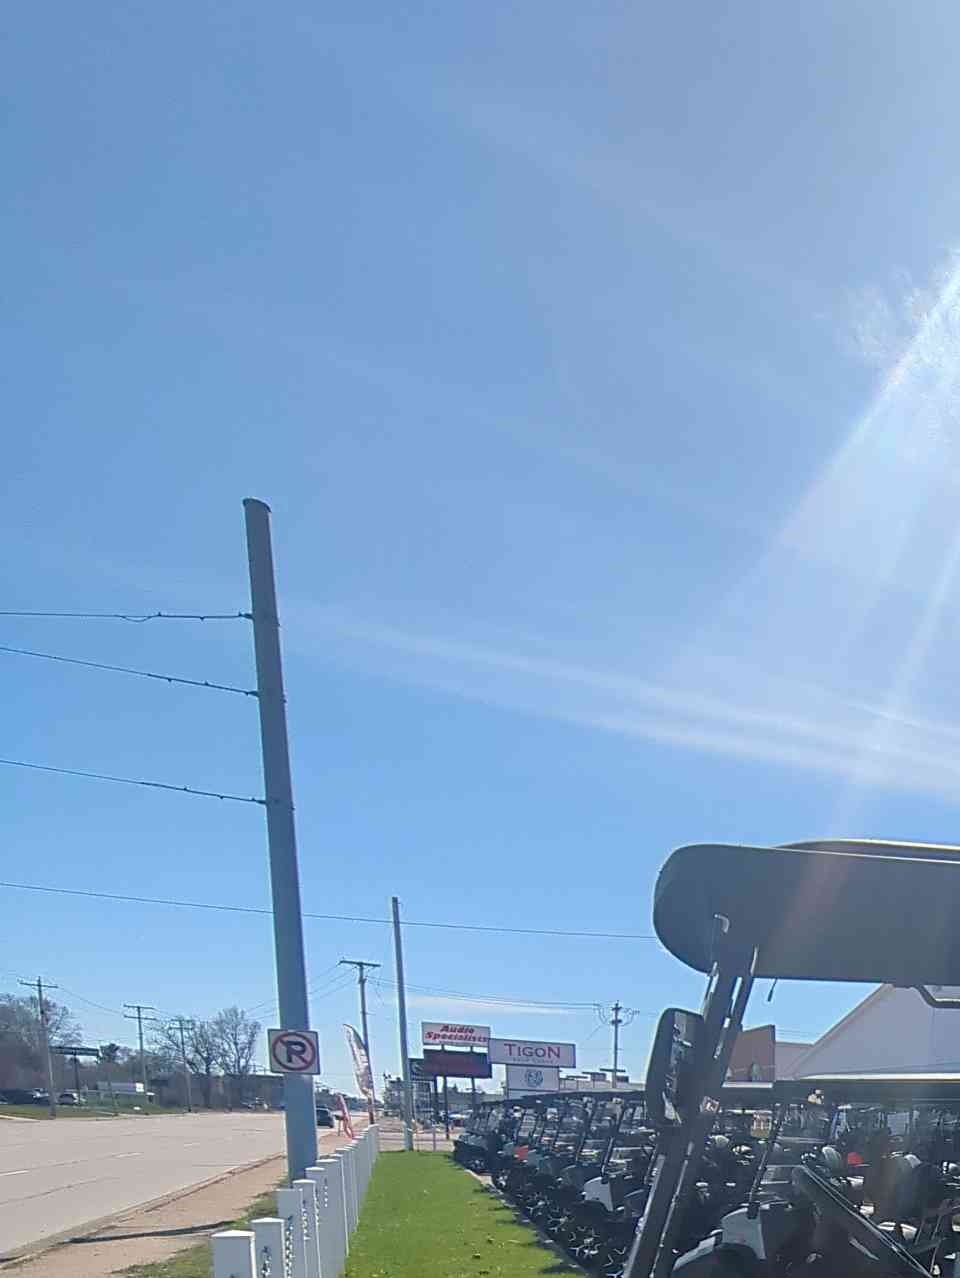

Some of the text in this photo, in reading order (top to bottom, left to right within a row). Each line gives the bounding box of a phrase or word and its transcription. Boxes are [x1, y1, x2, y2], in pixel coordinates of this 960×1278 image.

[440, 1024, 475, 1034] Audio
[425, 1031, 488, 1042] Specialists
[287, 1040, 306, 1063] P
[504, 1043, 560, 1059] TIGON
